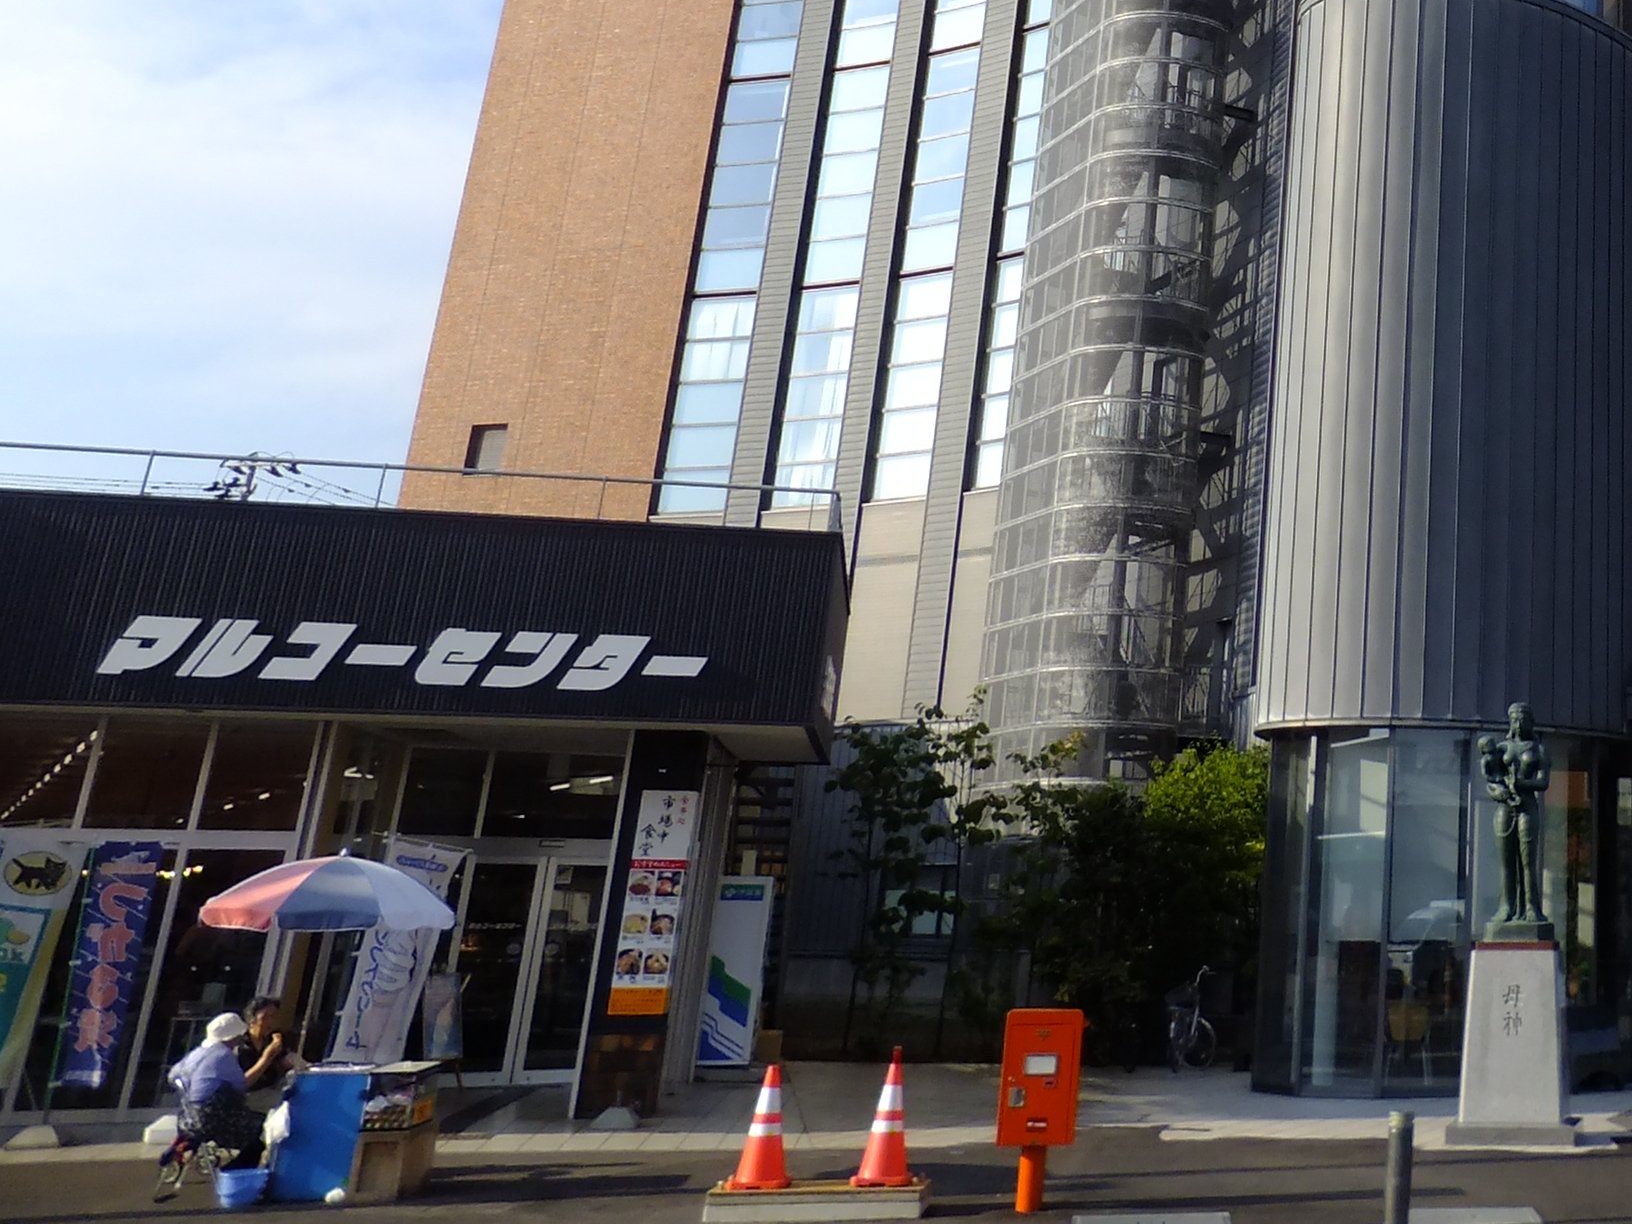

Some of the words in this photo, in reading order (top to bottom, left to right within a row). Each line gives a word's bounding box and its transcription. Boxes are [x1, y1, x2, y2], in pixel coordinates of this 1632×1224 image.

[96, 615, 708, 690] マルコーセンター
[1502, 984, 1522, 1036] 母神
